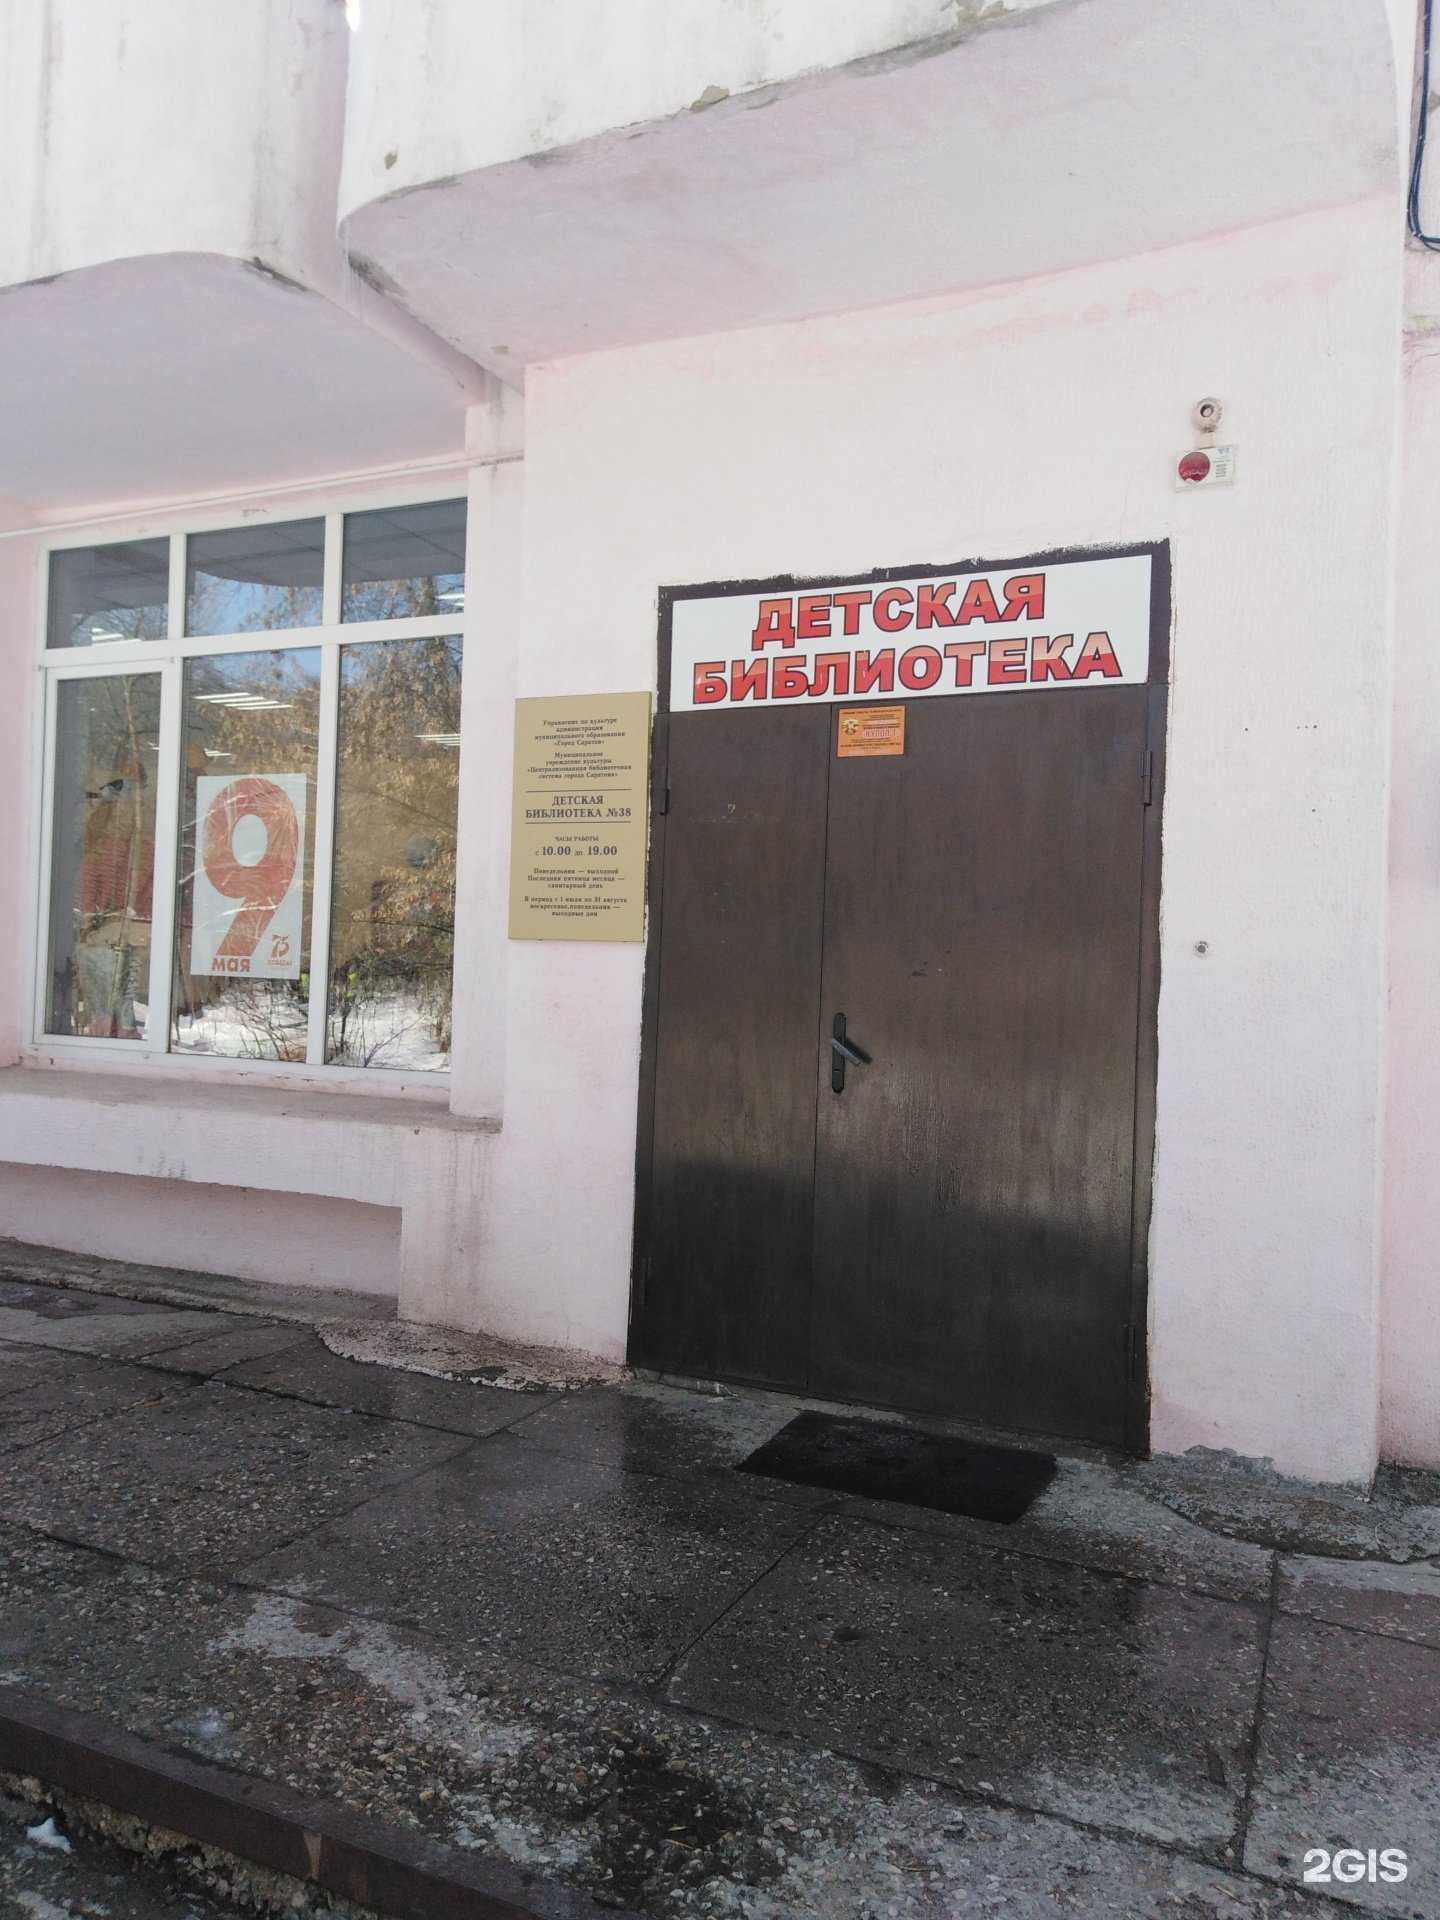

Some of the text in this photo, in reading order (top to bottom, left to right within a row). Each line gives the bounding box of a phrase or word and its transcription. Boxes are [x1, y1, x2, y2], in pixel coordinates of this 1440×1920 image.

[751, 573, 1046, 651] ДЕТСКАЯ
[692, 631, 1123, 705] БИБЛИОТЕКА
[525, 807, 632, 819] БИБЛИОТЕКА №38
[552, 795, 604, 806] ДЕТСКАЯ
[202, 777, 299, 956] 9
[542, 846, 571, 856] 10.00
[587, 845, 618, 856] 19.00
